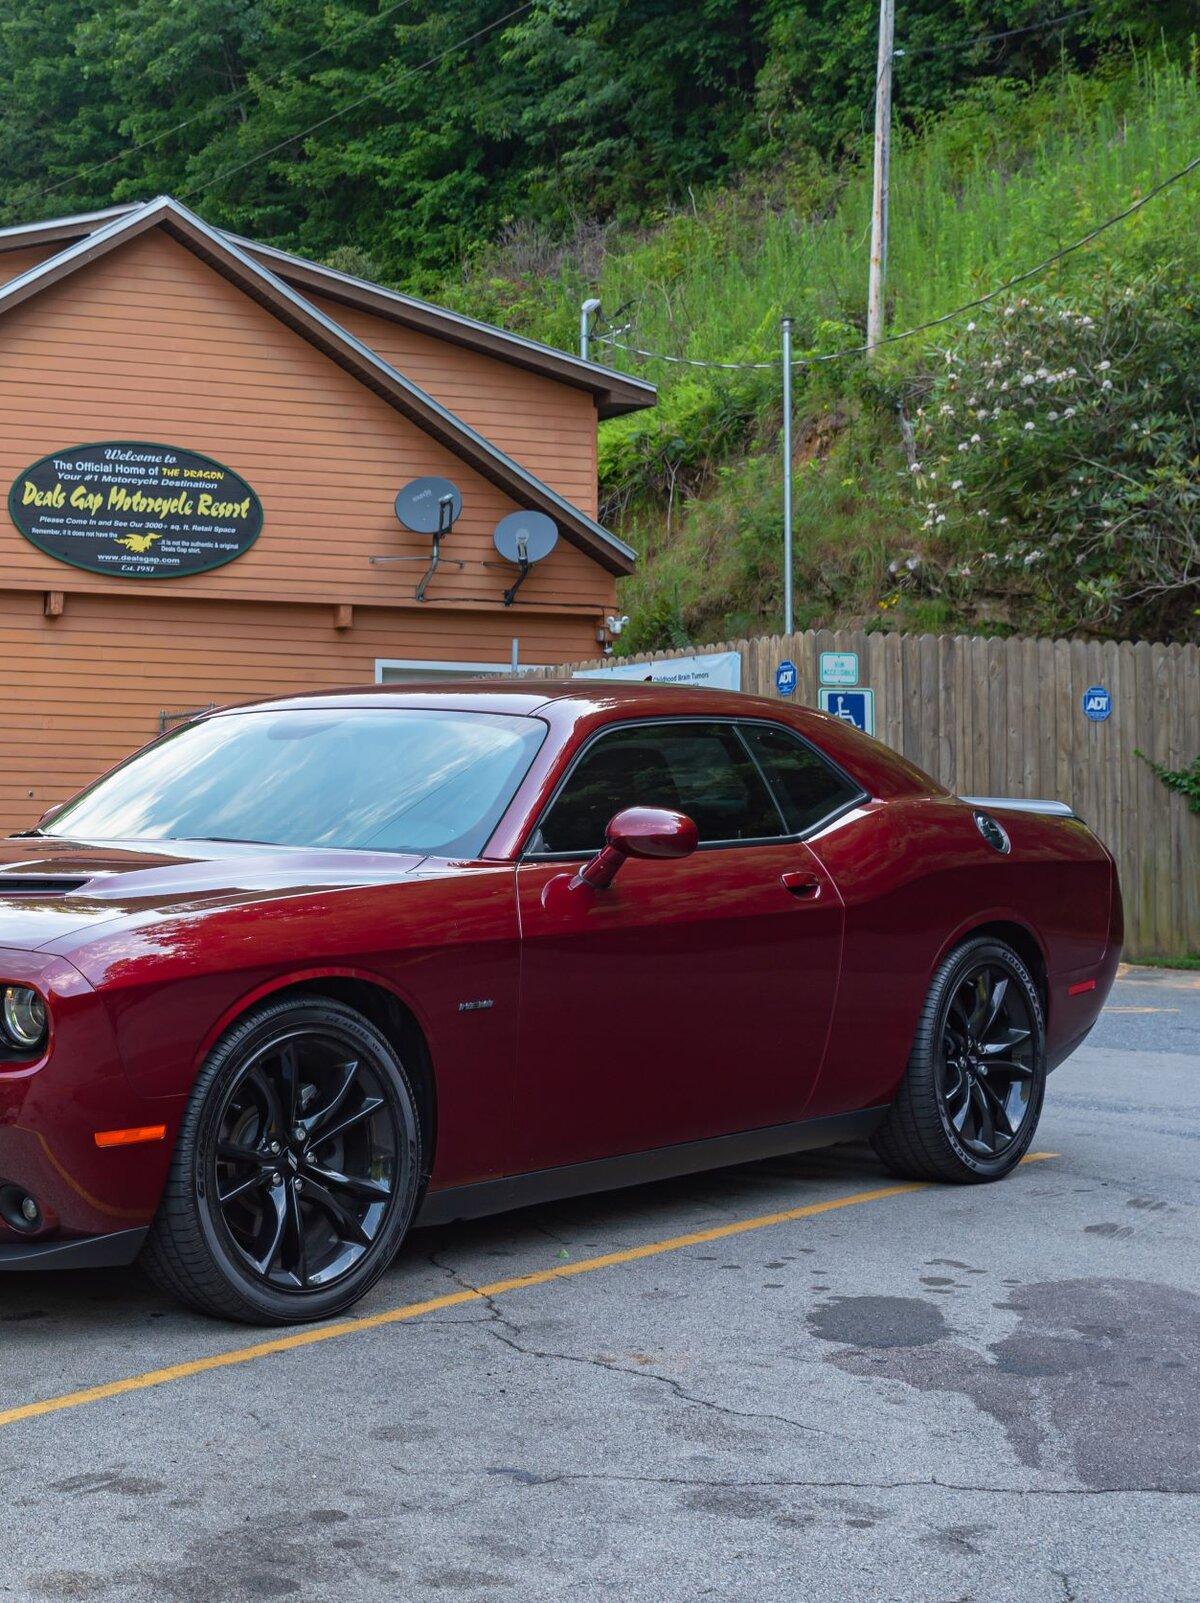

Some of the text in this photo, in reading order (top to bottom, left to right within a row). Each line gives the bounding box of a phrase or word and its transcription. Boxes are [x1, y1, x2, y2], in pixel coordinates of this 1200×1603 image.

[104, 448, 177, 464] Welcome to
[53, 460, 225, 480] The Official Home of THE DRAGON
[57, 472, 218, 490] Your #1 Motorcycle Destination
[22, 481, 251, 520] Deals Gap Motorcycle Resort
[39, 515, 64, 524] Please
[66, 517, 88, 525] Come
[89, 518, 97, 526] In
[98, 519, 112, 527] and
[113, 520, 128, 528] See
[129, 520, 143, 528] Our
[144, 521, 168, 530] 3000+
[192, 524, 213, 533] Retail
[214, 526, 236, 534] Space
[97, 554, 180, 565] www.dealsgap.com
[678, 673, 691, 681] Brain
[691, 672, 709, 680] Tumors
[778, 670, 794, 684] ADT
[1086, 696, 1109, 711] ADT
